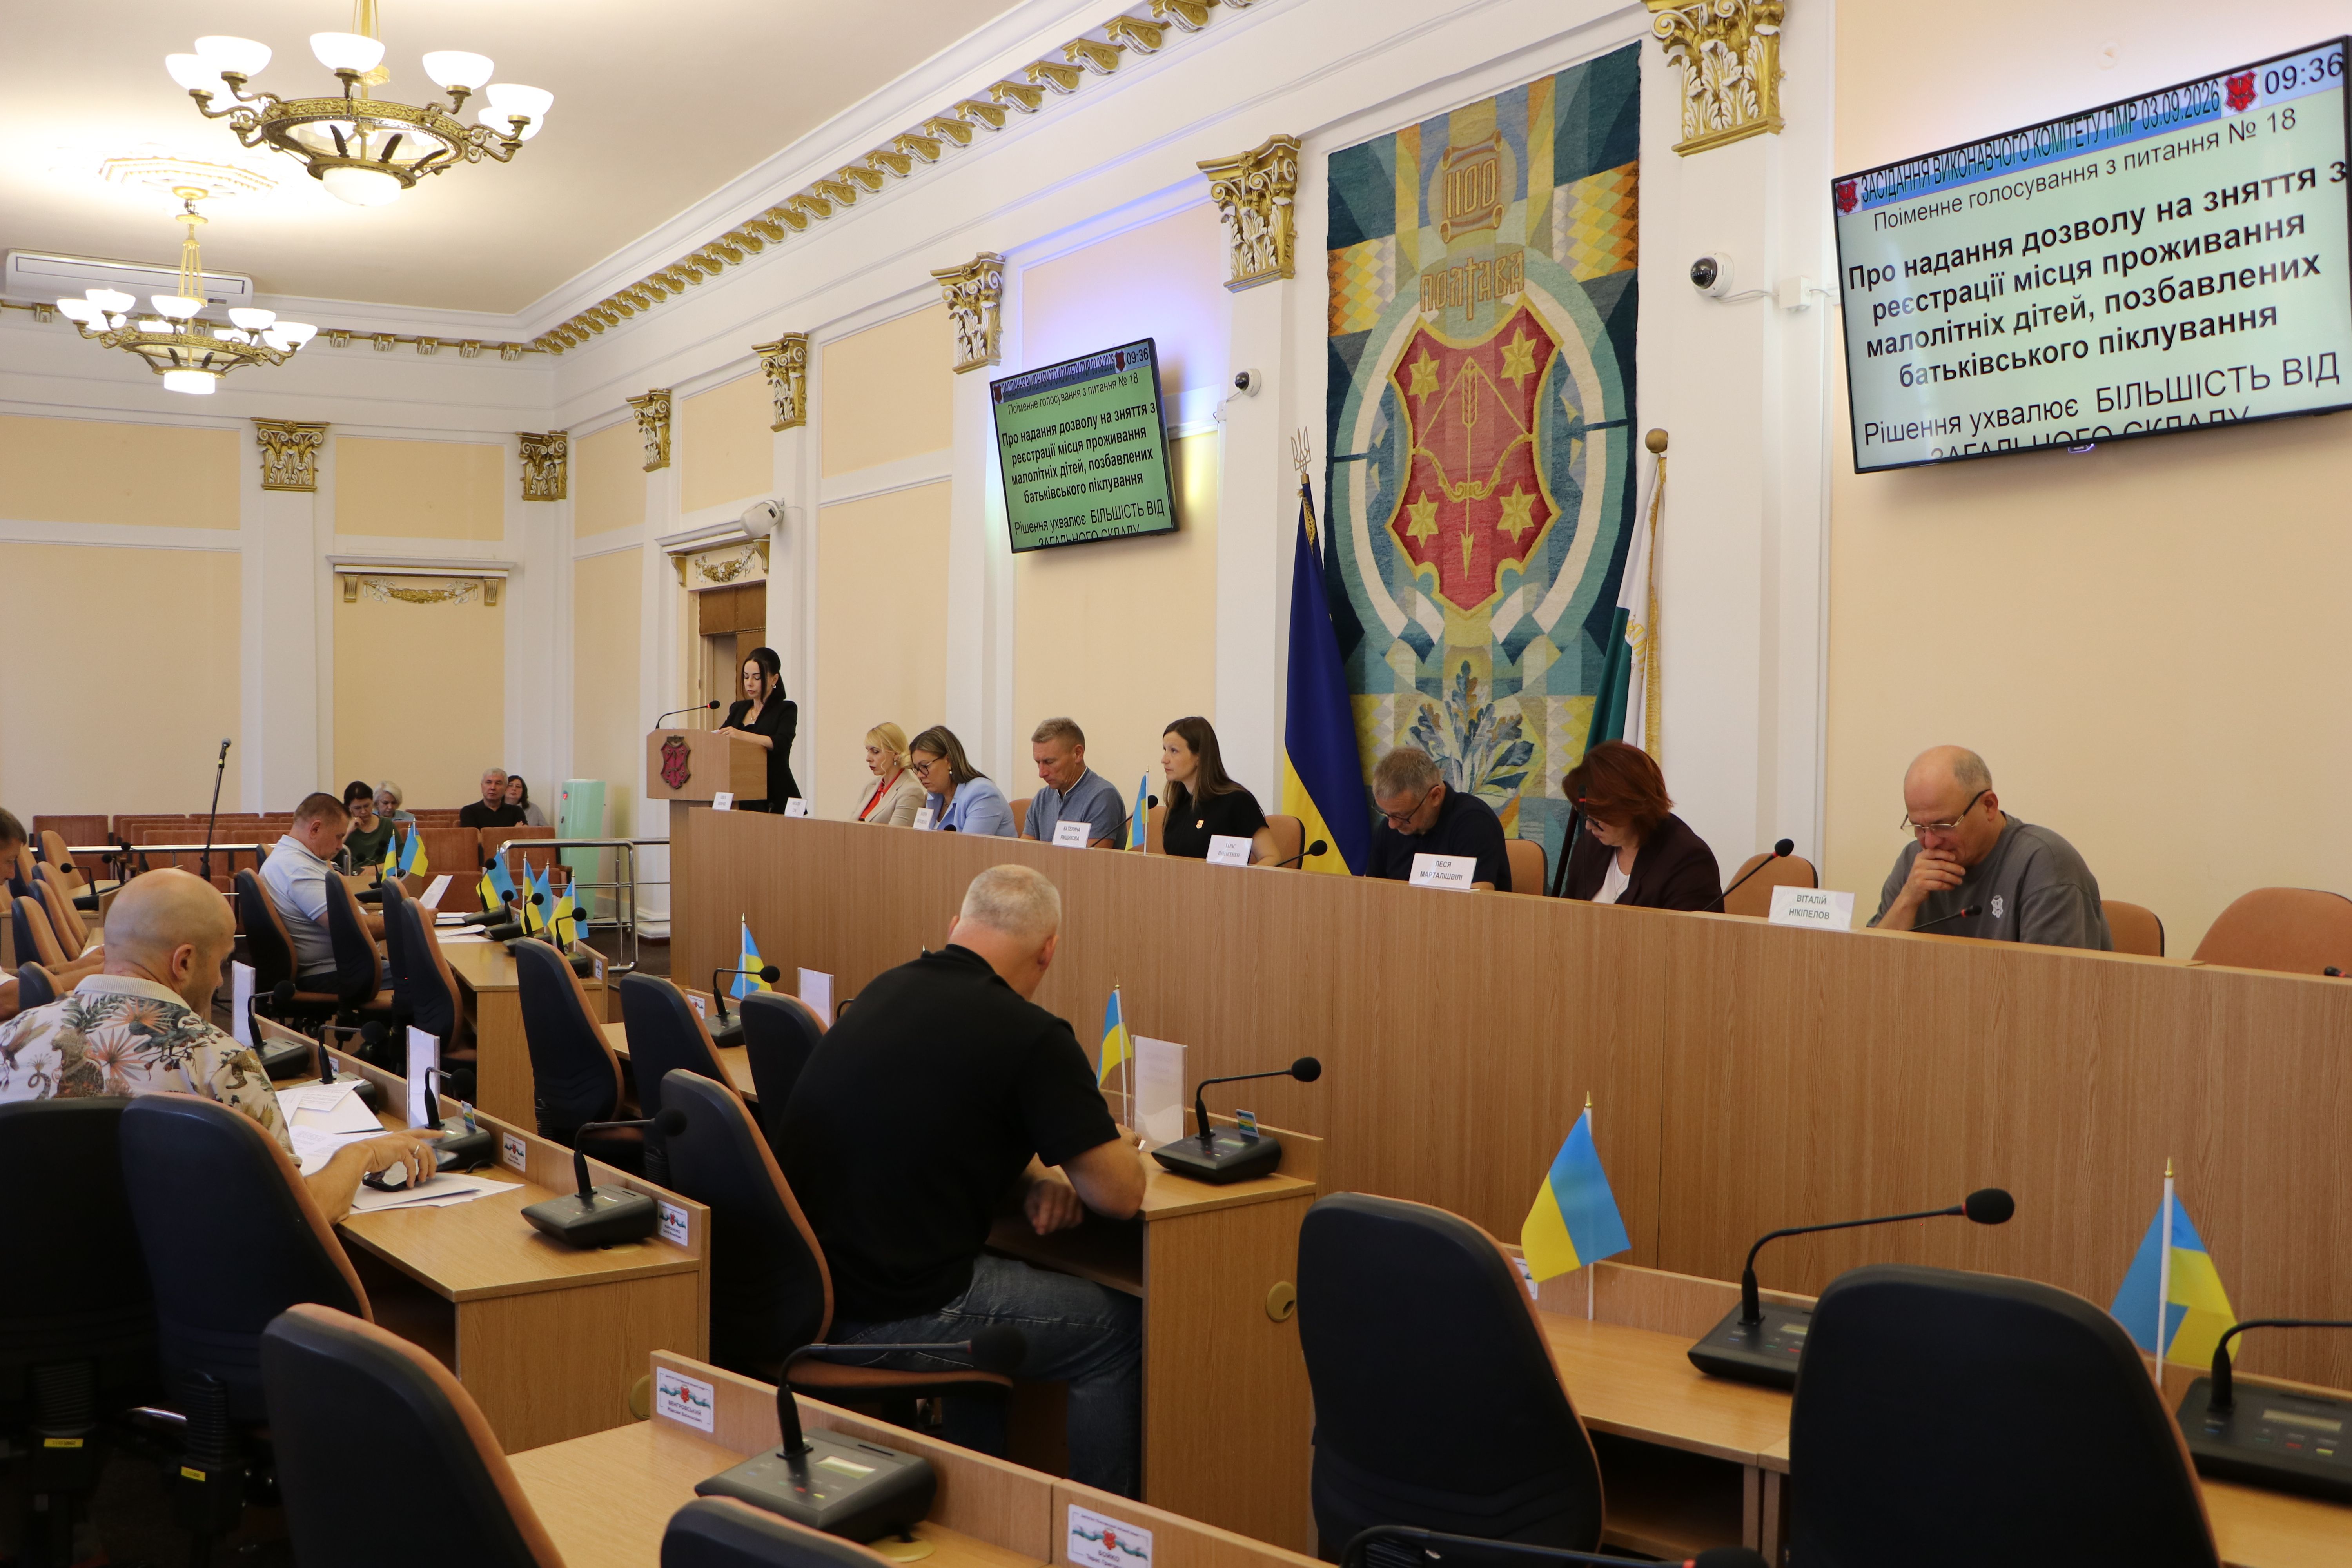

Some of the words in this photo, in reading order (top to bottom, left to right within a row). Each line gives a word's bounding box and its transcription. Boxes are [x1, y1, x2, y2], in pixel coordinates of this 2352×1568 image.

[2265, 52, 2343, 94] 09:36
[1861, 158, 1931, 204] ЗАСІДАННЯ
[1933, 132, 2030, 185] ВИКОНАВЧОГО
[2033, 110, 2101, 159] КОМІТЕТУ
[2105, 102, 2137, 140] ПМР
[2141, 79, 2220, 130] 03.09.2026
[1446, 158, 1496, 218] 1100
[1874, 197, 1962, 231] Поіменне
[1969, 163, 2098, 209] голосування
[2106, 160, 2116, 175] з
[2124, 132, 2219, 171] питання
[2229, 120, 2256, 144] №
[2267, 108, 2296, 133] 18
[1849, 264, 1896, 292] Про
[1904, 237, 2013, 278] надання
[2022, 207, 2145, 256] дозволу
[2157, 196, 2192, 223] на
[2203, 167, 2316, 212] зняття
[2329, 161, 2347, 183] з
[1873, 271, 2005, 326] реєстрації
[2014, 264, 2092, 292] місця
[2103, 214, 2304, 277] проживання
[1867, 313, 2005, 358] малолітніх
[2013, 294, 2094, 335] дітей,
[2104, 254, 2321, 314] позбавлених
[1127, 348, 1149, 365] 09:36
[1899, 339, 2089, 388] батьківського
[2098, 305, 2277, 355] піклування
[1008, 400, 1038, 415] Поіменне
[1040, 389, 1081, 405] голосування
[1083, 388, 1086, 396] з
[1088, 380, 1117, 395] питання
[1118, 376, 1127, 387] №
[1129, 372, 1138, 385] 18
[1026, 368, 1058, 392] ВИКОНАВЧОГО
[1058, 364, 1079, 383] КОМІТЕТУ
[1080, 359, 1090, 377] ПМР
[1864, 416, 1961, 446] Рішення
[1969, 397, 2078, 437] ухвалює
[2096, 365, 2270, 413] БІЛЬШІСТЬ
[2282, 351, 2340, 388] ВІД
[1002, 433, 1018, 448] Про
[1020, 425, 1057, 442] надання
[1060, 415, 1097, 436] дозволу
[1100, 412, 1112, 425] на
[1114, 404, 1147, 421] зняття
[1150, 402, 1156, 413] з
[1011, 465, 1058, 485] малолітніх
[1060, 459, 1086, 479] дітей,
[1089, 448, 1153, 471] позбавлених
[1012, 443, 1056, 468] реєстрації
[1058, 441, 1083, 454] місця
[1086, 427, 1147, 452] проживання
[1024, 483, 1086, 503] батьківського
[1089, 473, 1143, 493] піклування
[1014, 520, 1048, 535] Рішення
[1050, 515, 1086, 533] ухвалює
[1090, 503, 1144, 524] БІЛЬШІСТЬ
[1147, 499, 1165, 517] ВІД
[1420, 871, 1463, 881] МАРТАЛІШВІЛІ
[1789, 908, 1830, 919] НІКІПЕЛОВ
[1797, 895, 1827, 905] ВІТАЛІЙ
